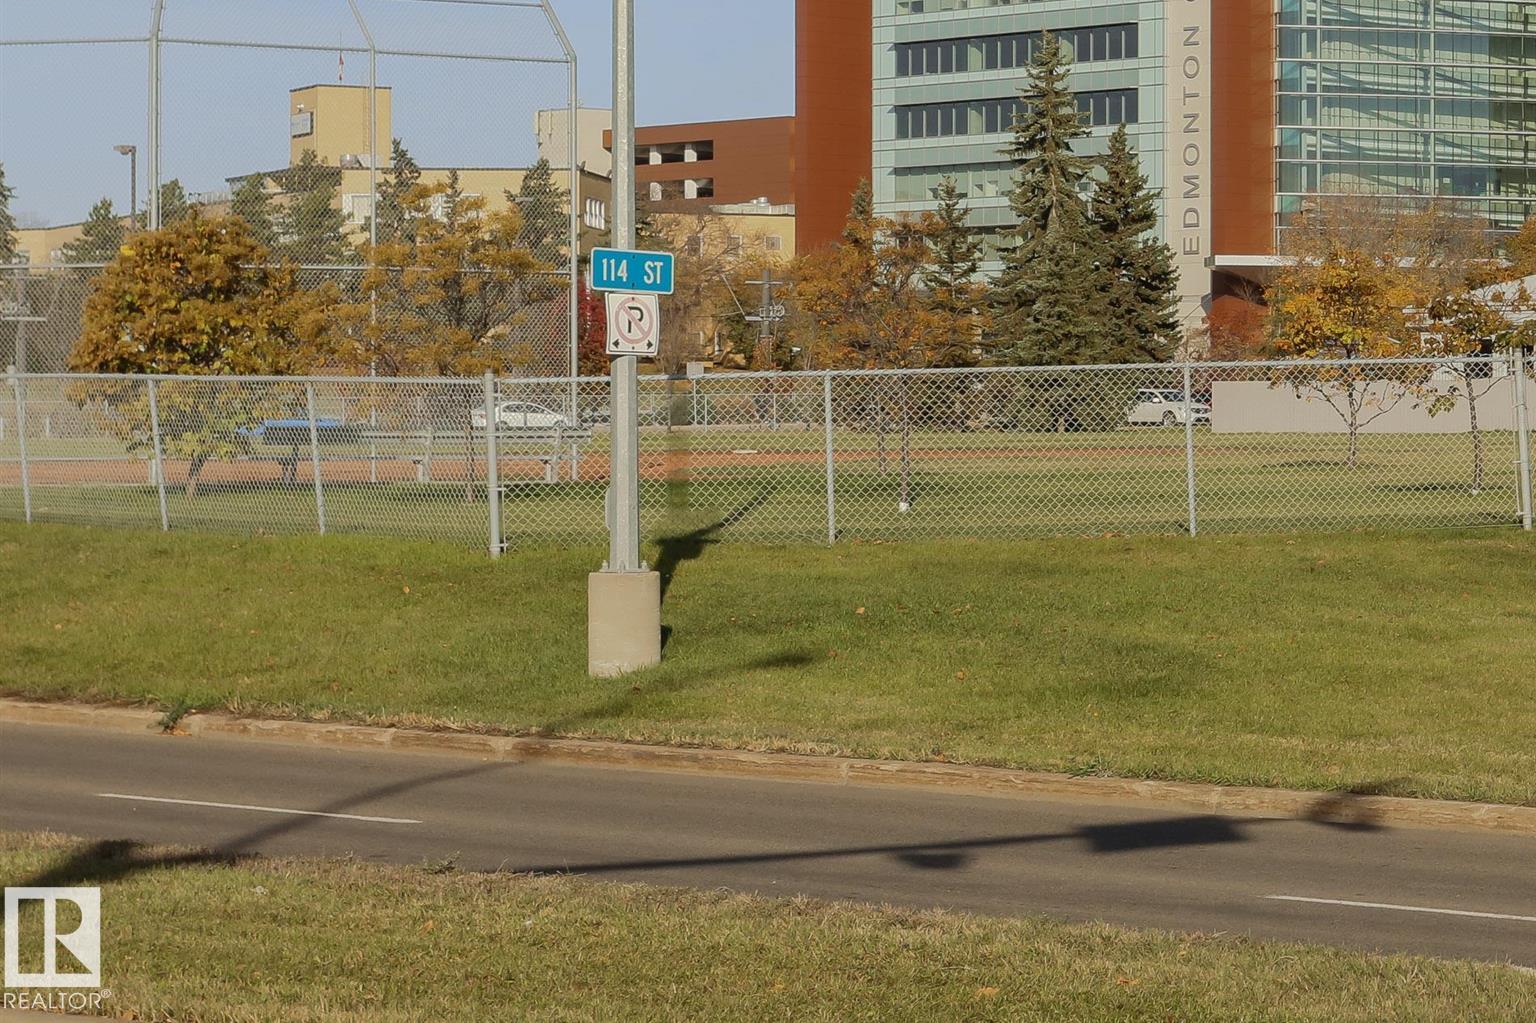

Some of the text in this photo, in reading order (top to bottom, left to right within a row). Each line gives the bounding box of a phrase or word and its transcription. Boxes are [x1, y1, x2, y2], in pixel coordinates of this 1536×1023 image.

[1182, 25, 1201, 256] EDMONTON
[602, 258, 664, 284] 114 ST
